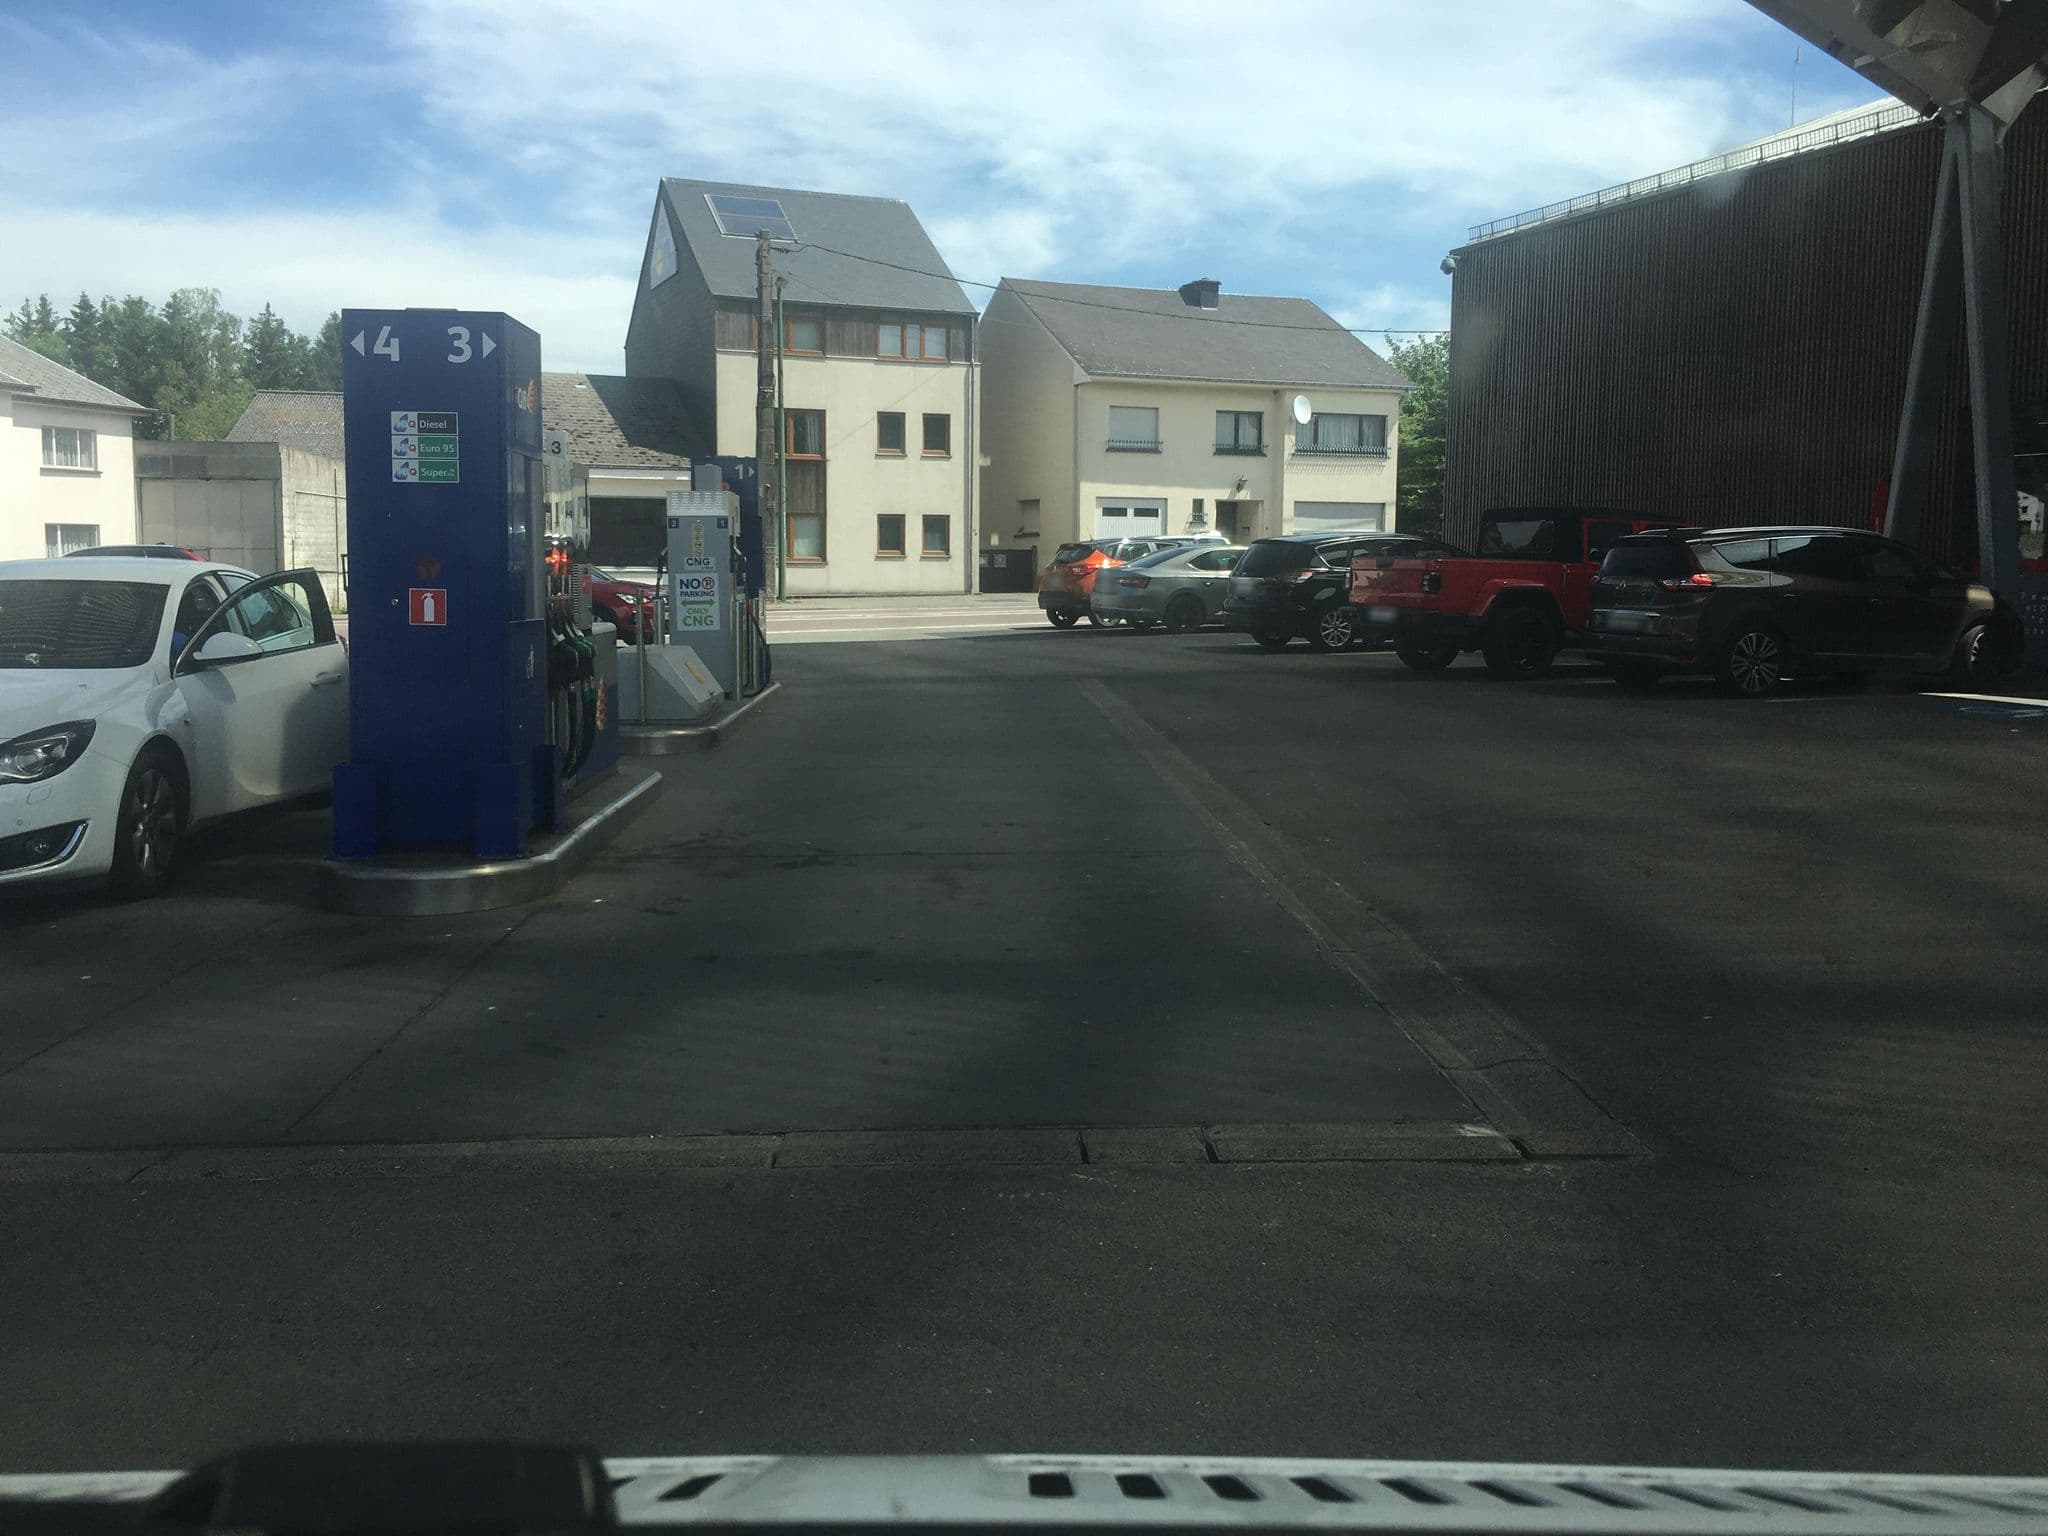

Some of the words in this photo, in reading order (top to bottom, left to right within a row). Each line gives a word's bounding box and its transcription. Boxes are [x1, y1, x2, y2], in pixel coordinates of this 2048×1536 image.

[373, 325, 400, 362] 4
[447, 325, 473, 364] 3
[419, 420, 447, 429] Diesel
[420, 444, 441, 453] Euro
[442, 444, 455, 453] 95
[551, 441, 562, 455] 3
[421, 468, 448, 479] Super
[734, 464, 744, 480] 1
[671, 519, 677, 528] 2
[719, 519, 725, 528] 1
[686, 557, 710, 567] CNG
[679, 578, 700, 590] NO
[680, 590, 715, 598] PARKING
[682, 615, 714, 627] CNG
